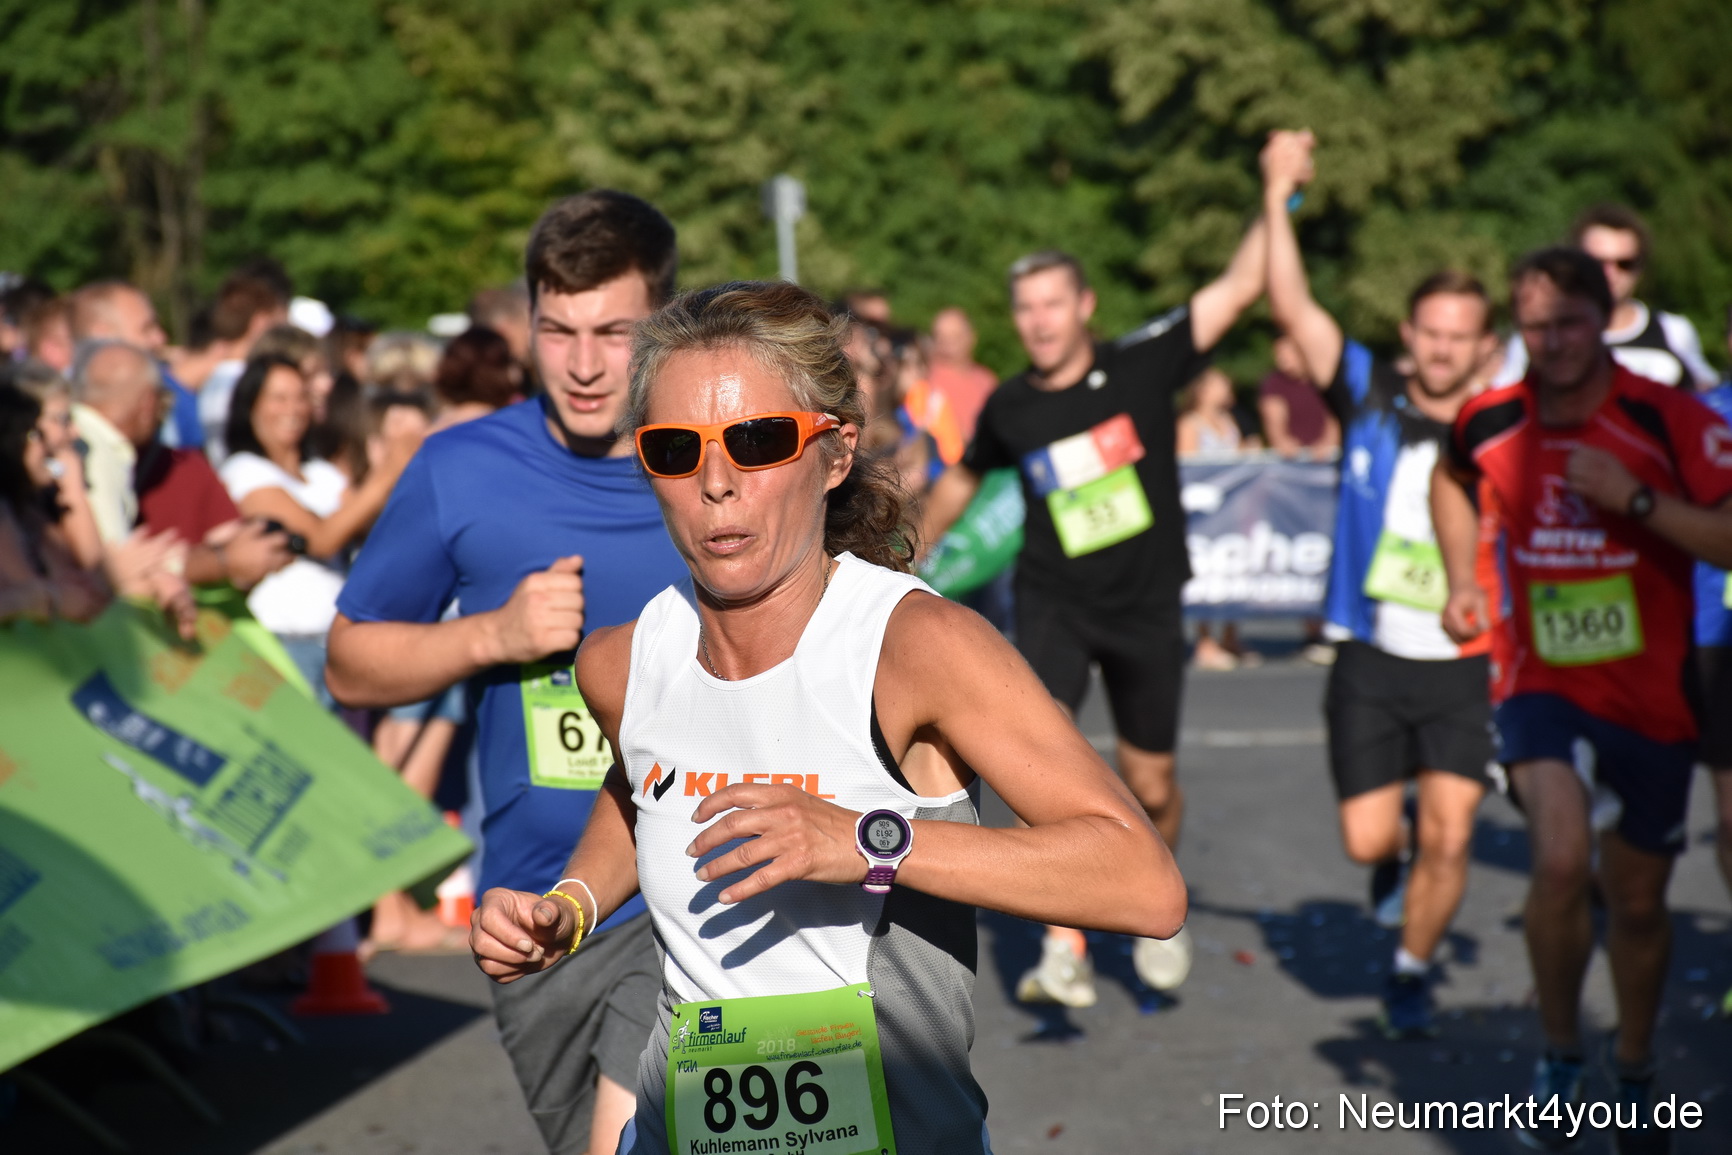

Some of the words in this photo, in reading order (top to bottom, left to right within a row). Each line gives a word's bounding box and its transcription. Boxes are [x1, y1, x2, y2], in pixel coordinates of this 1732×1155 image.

[1544, 605, 1624, 641] 1360
[688, 1027, 747, 1047] firmenlauf
[757, 1038, 796, 1055] 2018
[704, 1061, 829, 1133] 896
[690, 1136, 780, 1155] Kuhlemann
[785, 1125, 859, 1149] Sylvana
